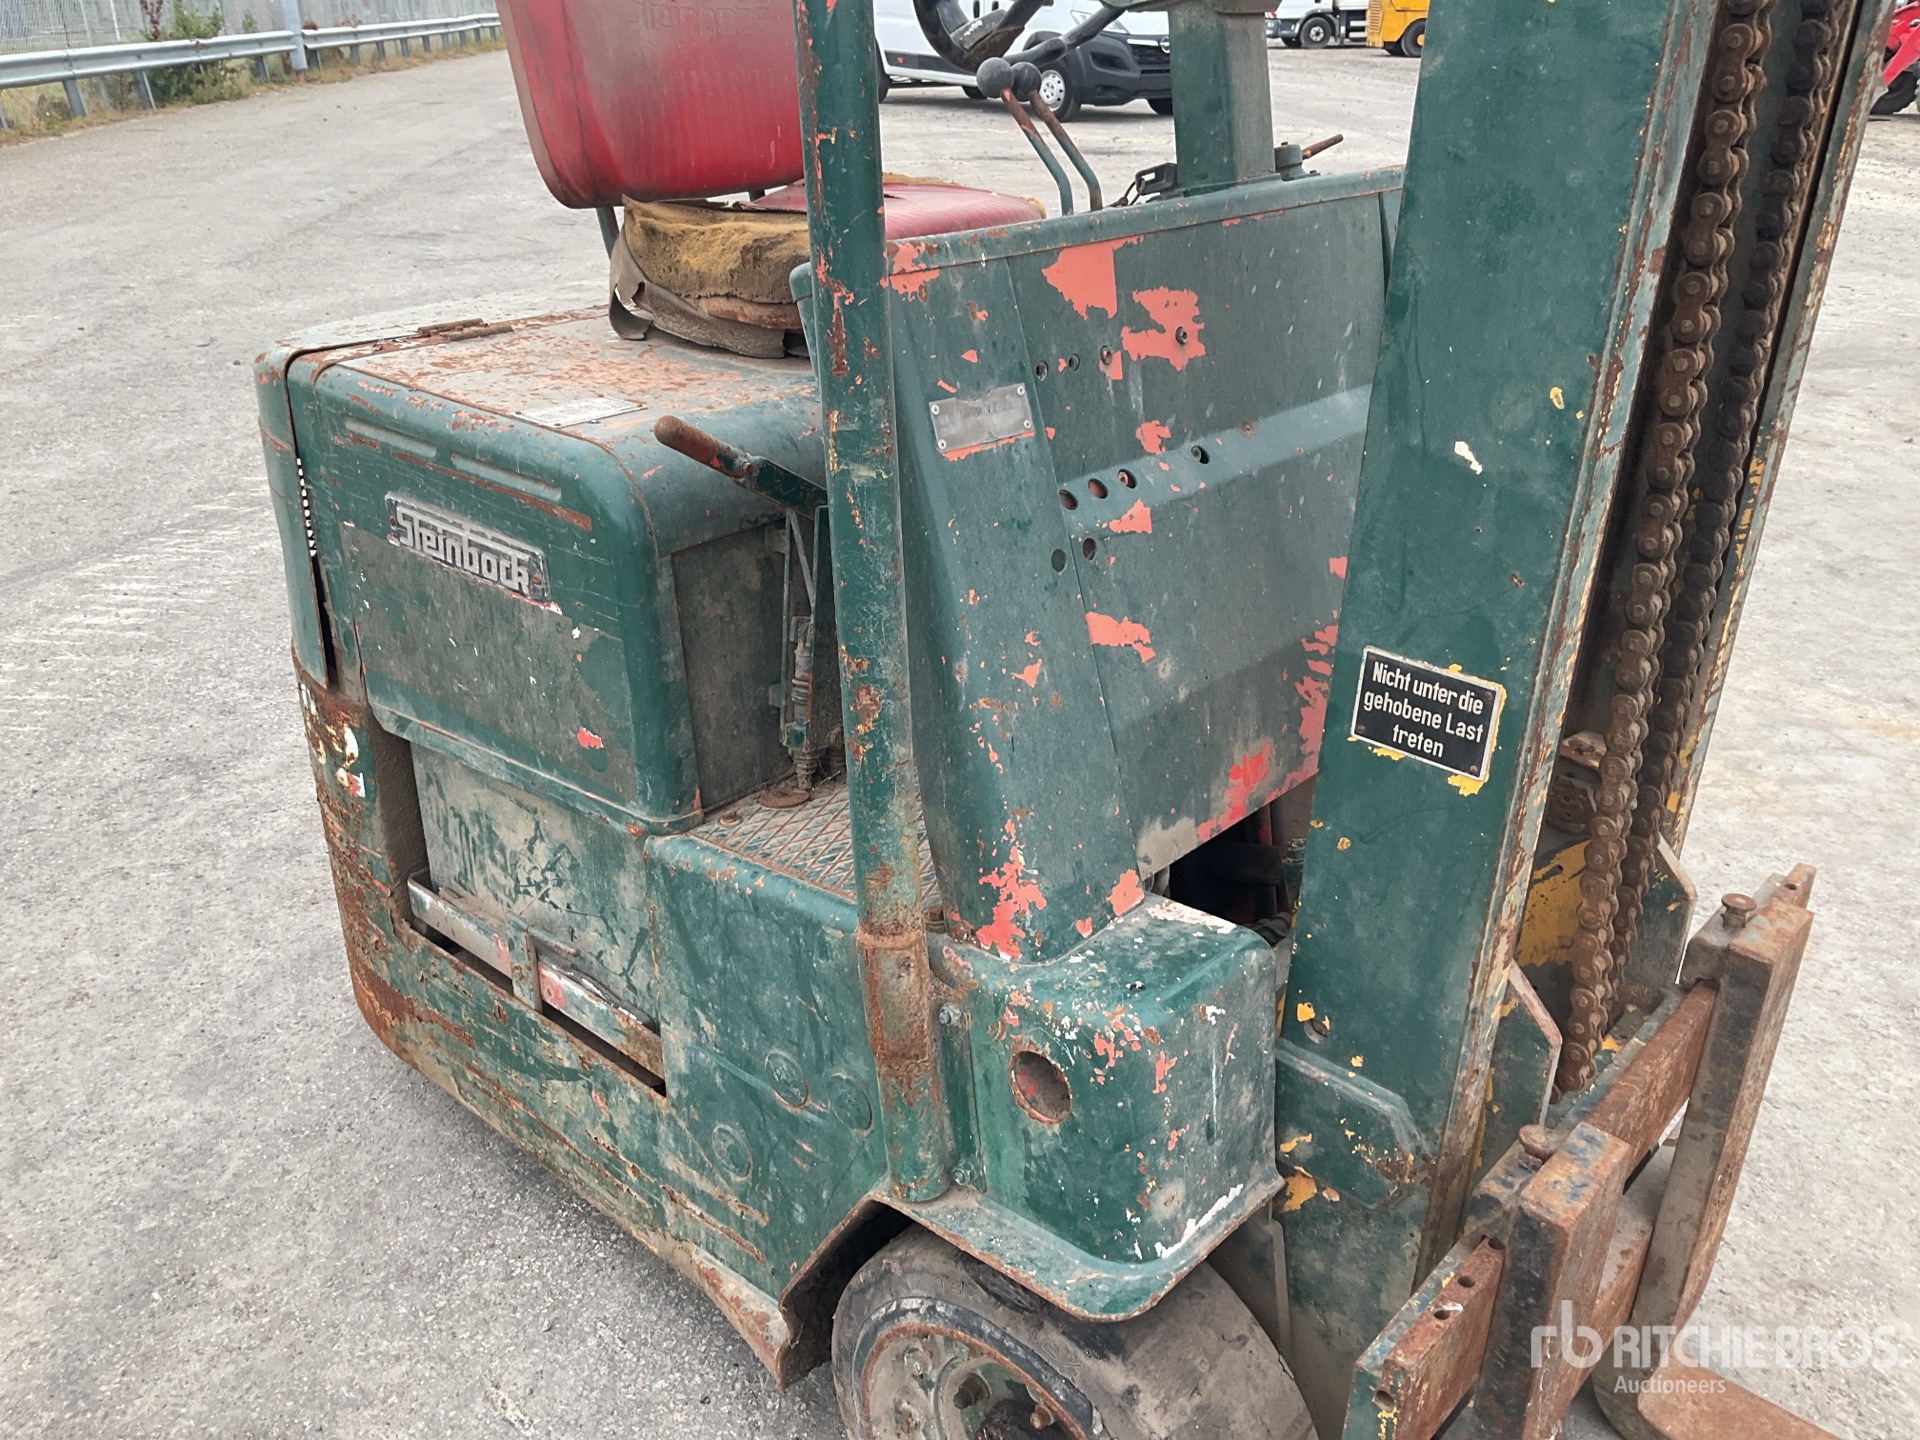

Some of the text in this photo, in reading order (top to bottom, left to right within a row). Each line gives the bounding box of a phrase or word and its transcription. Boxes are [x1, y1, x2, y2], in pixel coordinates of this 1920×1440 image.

[396, 505, 532, 597] Steinbock
[1372, 661, 1484, 715] Nicht unter die
[1363, 690, 1484, 743] gehobene Last
[1392, 724, 1444, 758] treten
